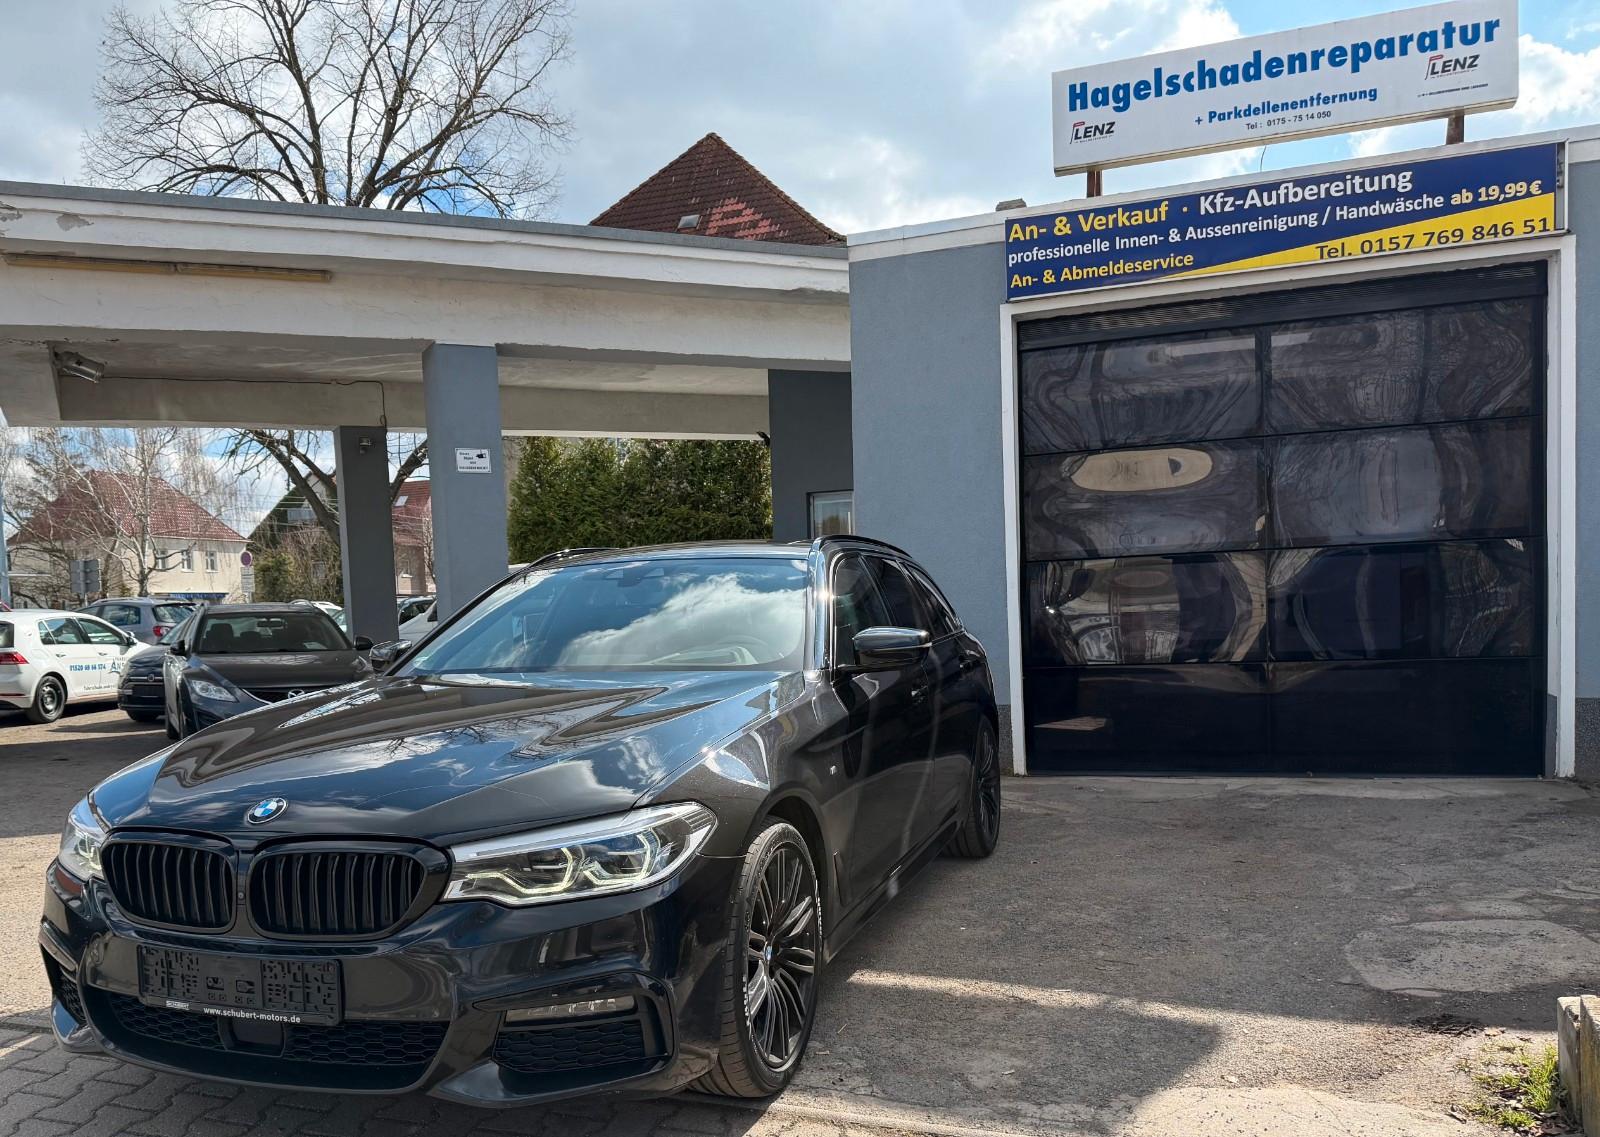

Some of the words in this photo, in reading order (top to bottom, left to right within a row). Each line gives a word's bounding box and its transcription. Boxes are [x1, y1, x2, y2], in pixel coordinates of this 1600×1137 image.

[1067, 16, 1501, 113] Hagelschadenreparatur
[1429, 54, 1480, 76] LENZ
[1208, 88, 1378, 124] Parkdellenentfernung
[1267, 118, 1286, 127] 0175
[1293, 115, 1303, 124] 75
[1305, 113, 1315, 121] 14
[1317, 110, 1332, 120] 050
[1074, 121, 1116, 141] LENZ
[1008, 224, 1047, 243] An-
[1054, 216, 1072, 237] &
[1078, 201, 1169, 233] Verkauf
[1199, 171, 1413, 216] Kfz-Aufbereitung
[1008, 237, 1110, 267] professionelle
[1116, 233, 1164, 250] Innen-
[1169, 229, 1181, 243] &
[1185, 211, 1318, 241] Aussenreinigung
[1322, 206, 1331, 226] /
[1336, 194, 1445, 222] Handwäsche
[1451, 187, 1473, 206] ab
[1478, 181, 1528, 203] 19,99
[1529, 180, 1543, 195] €
[1315, 242, 1353, 260] Tel.
[1360, 234, 1415, 255] 0157
[1423, 228, 1465, 247] 769
[1472, 221, 1515, 241] 846
[1523, 217, 1550, 235] 51
[1010, 273, 1038, 289] An-
[1042, 268, 1056, 284] &
[1060, 251, 1194, 282] Abmeldeservice
[203, 1006, 301, 1024] www.schubert-motors.de
